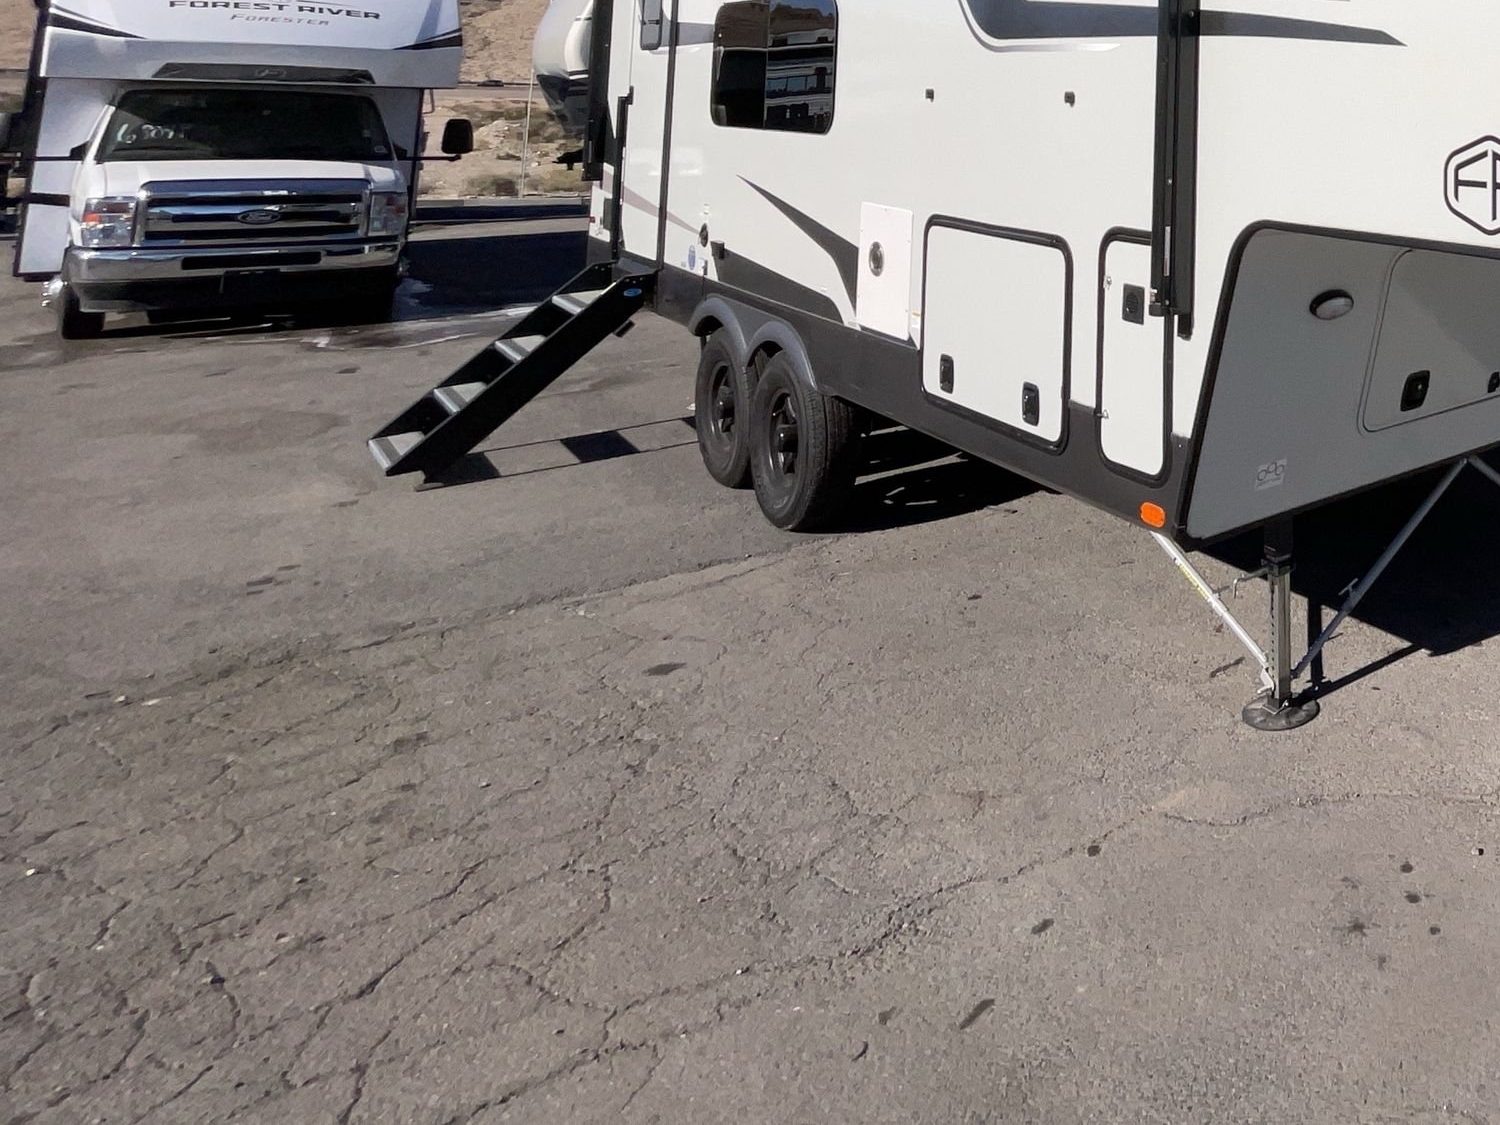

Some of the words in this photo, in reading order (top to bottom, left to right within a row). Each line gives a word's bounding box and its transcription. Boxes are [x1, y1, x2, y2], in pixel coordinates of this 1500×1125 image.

[169, 0, 290, 11] FOREST
[297, 5, 381, 20] RIVER
[230, 13, 330, 26] FORESTER
